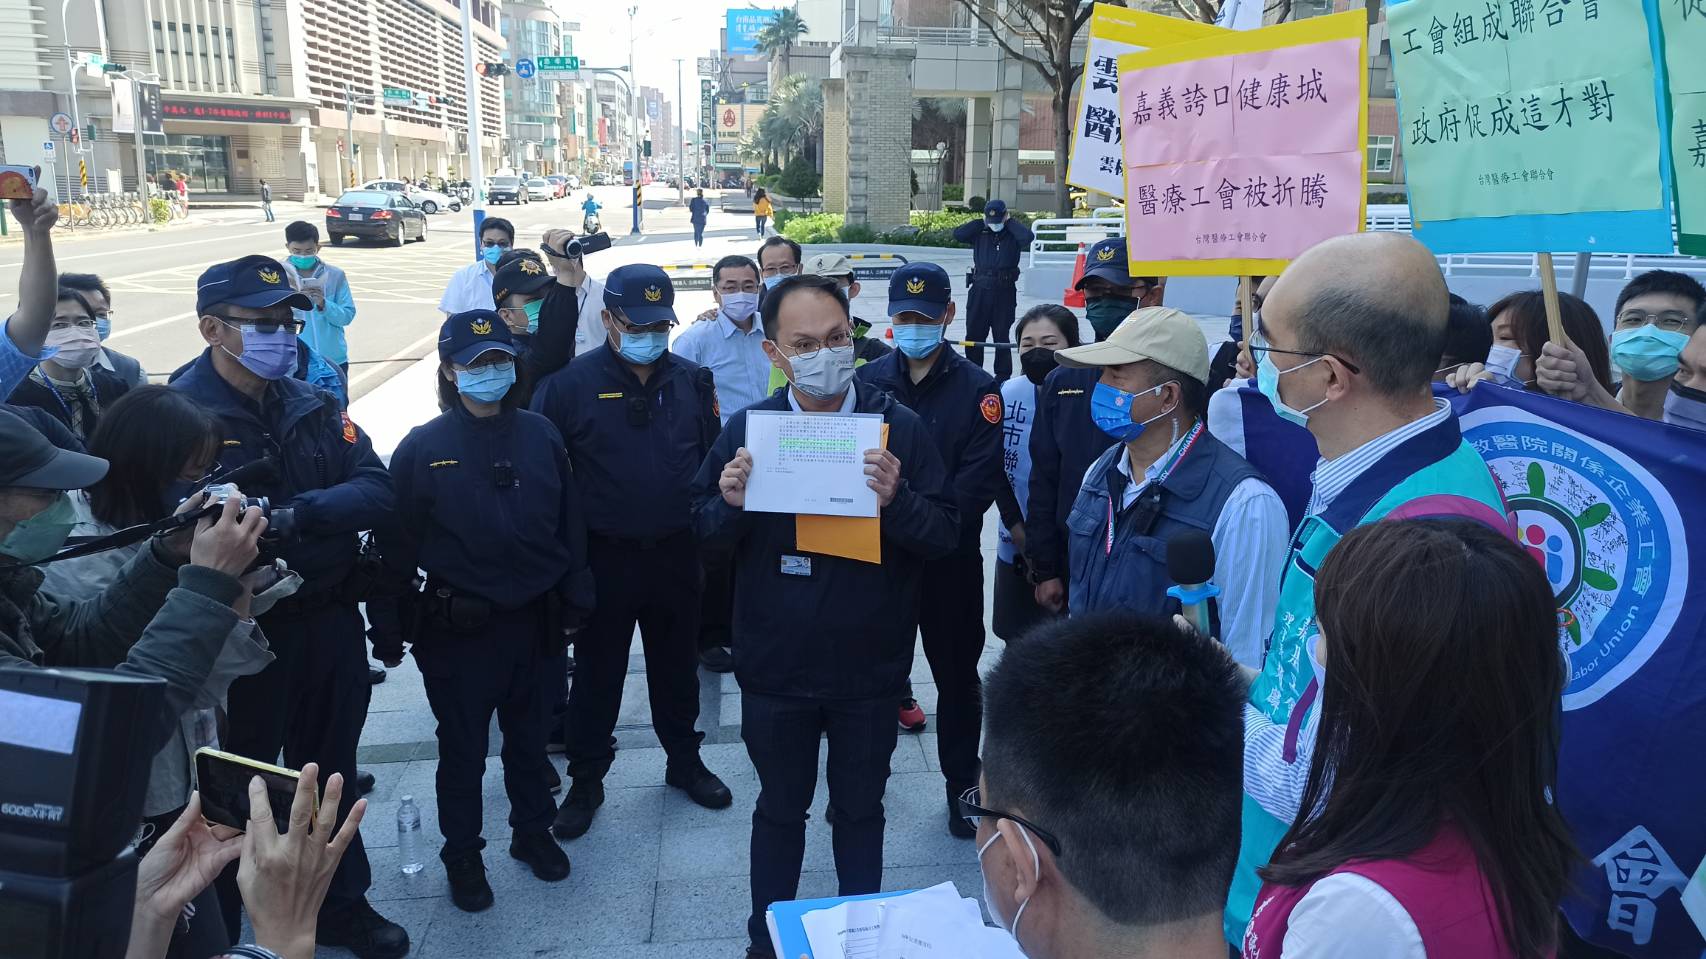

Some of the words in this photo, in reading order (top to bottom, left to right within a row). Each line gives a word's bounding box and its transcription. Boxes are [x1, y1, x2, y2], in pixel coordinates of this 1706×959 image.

[1084, 104, 1123, 145] 醫
[1411, 80, 1616, 145] 政府促成這才對
[1138, 173, 1329, 216] 醫療工會被折騰
[1600, 605, 1639, 657] Union
[1590, 824, 1690, 945] 會
